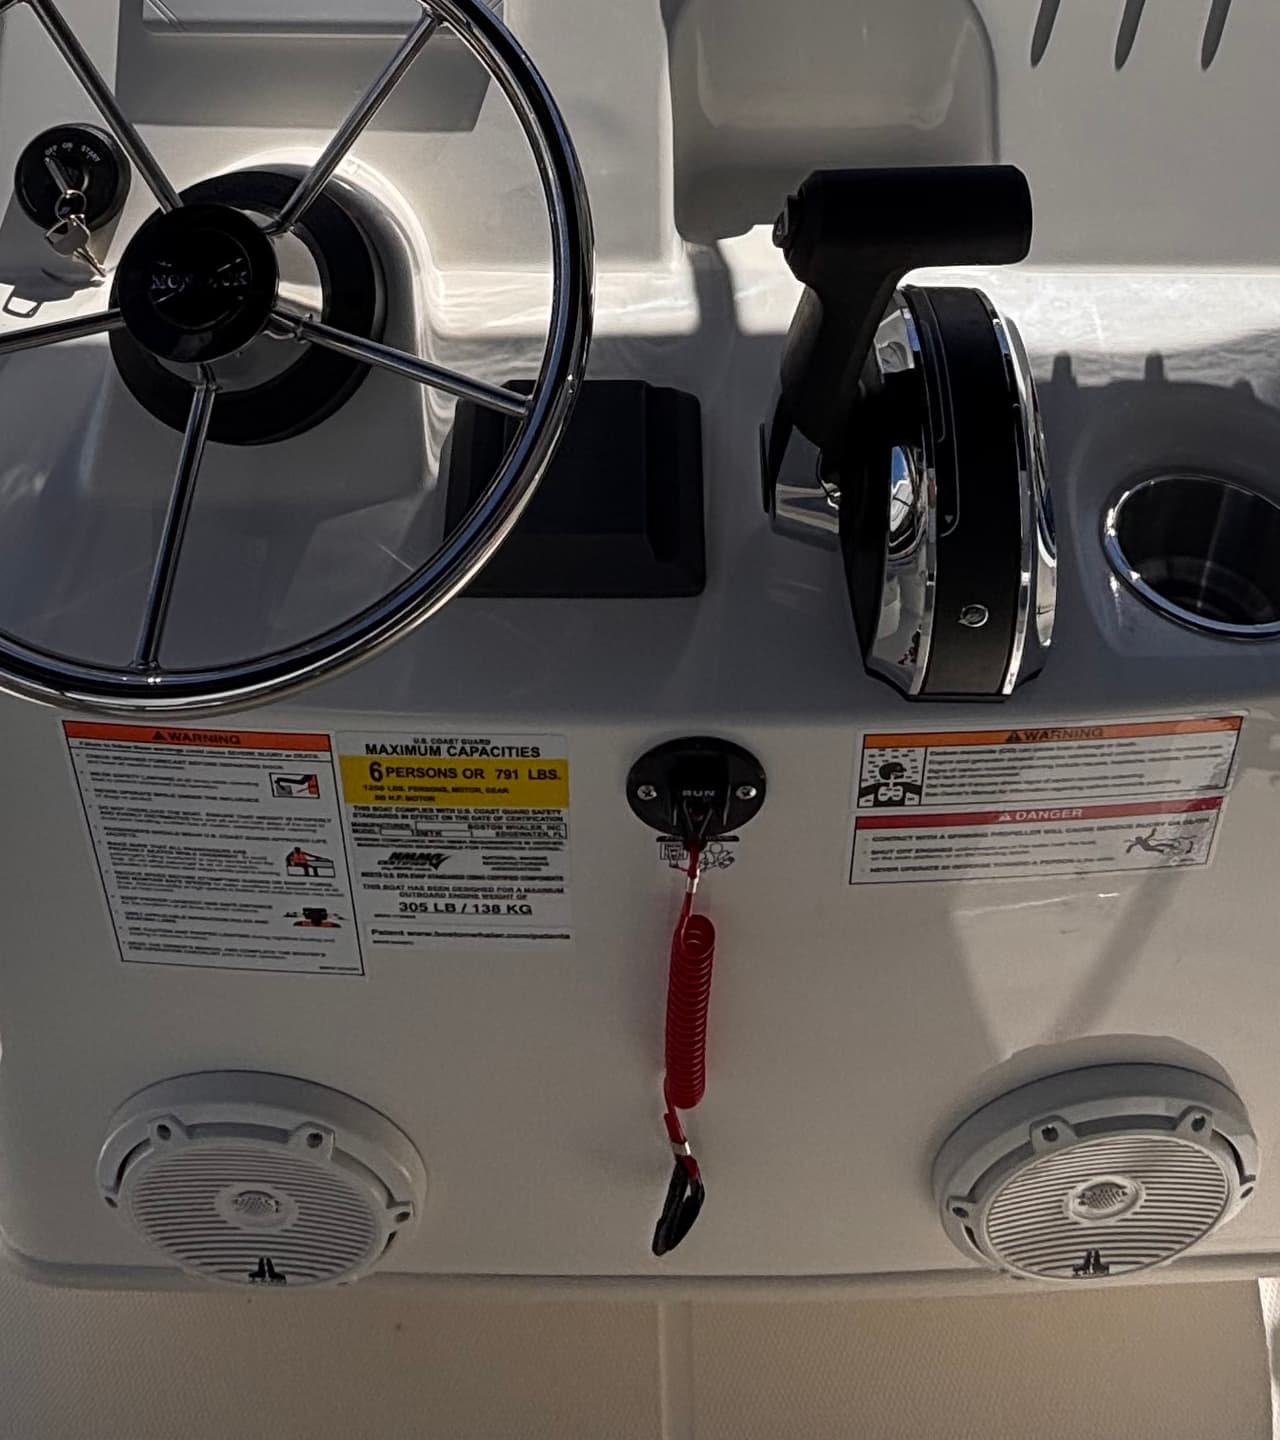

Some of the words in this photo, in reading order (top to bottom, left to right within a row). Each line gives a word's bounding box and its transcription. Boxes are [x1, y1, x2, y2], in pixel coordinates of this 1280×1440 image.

[167, 730, 240, 745] WARNING
[431, 738, 458, 746] COAST
[1021, 727, 1104, 743] WARNING
[364, 743, 440, 757] MAXIMUM
[445, 745, 540, 758] CAPACITIES
[370, 761, 383, 782] 6
[386, 766, 457, 779] PERSONS
[462, 767, 485, 780] OR
[495, 768, 518, 779] 791
[527, 768, 561, 781] LBS.
[1015, 808, 1083, 823] DANGER
[398, 902, 428, 912] 305
[433, 903, 456, 913] LB
[459, 903, 467, 913] /
[472, 904, 500, 914] 138
[506, 904, 532, 914] KG
